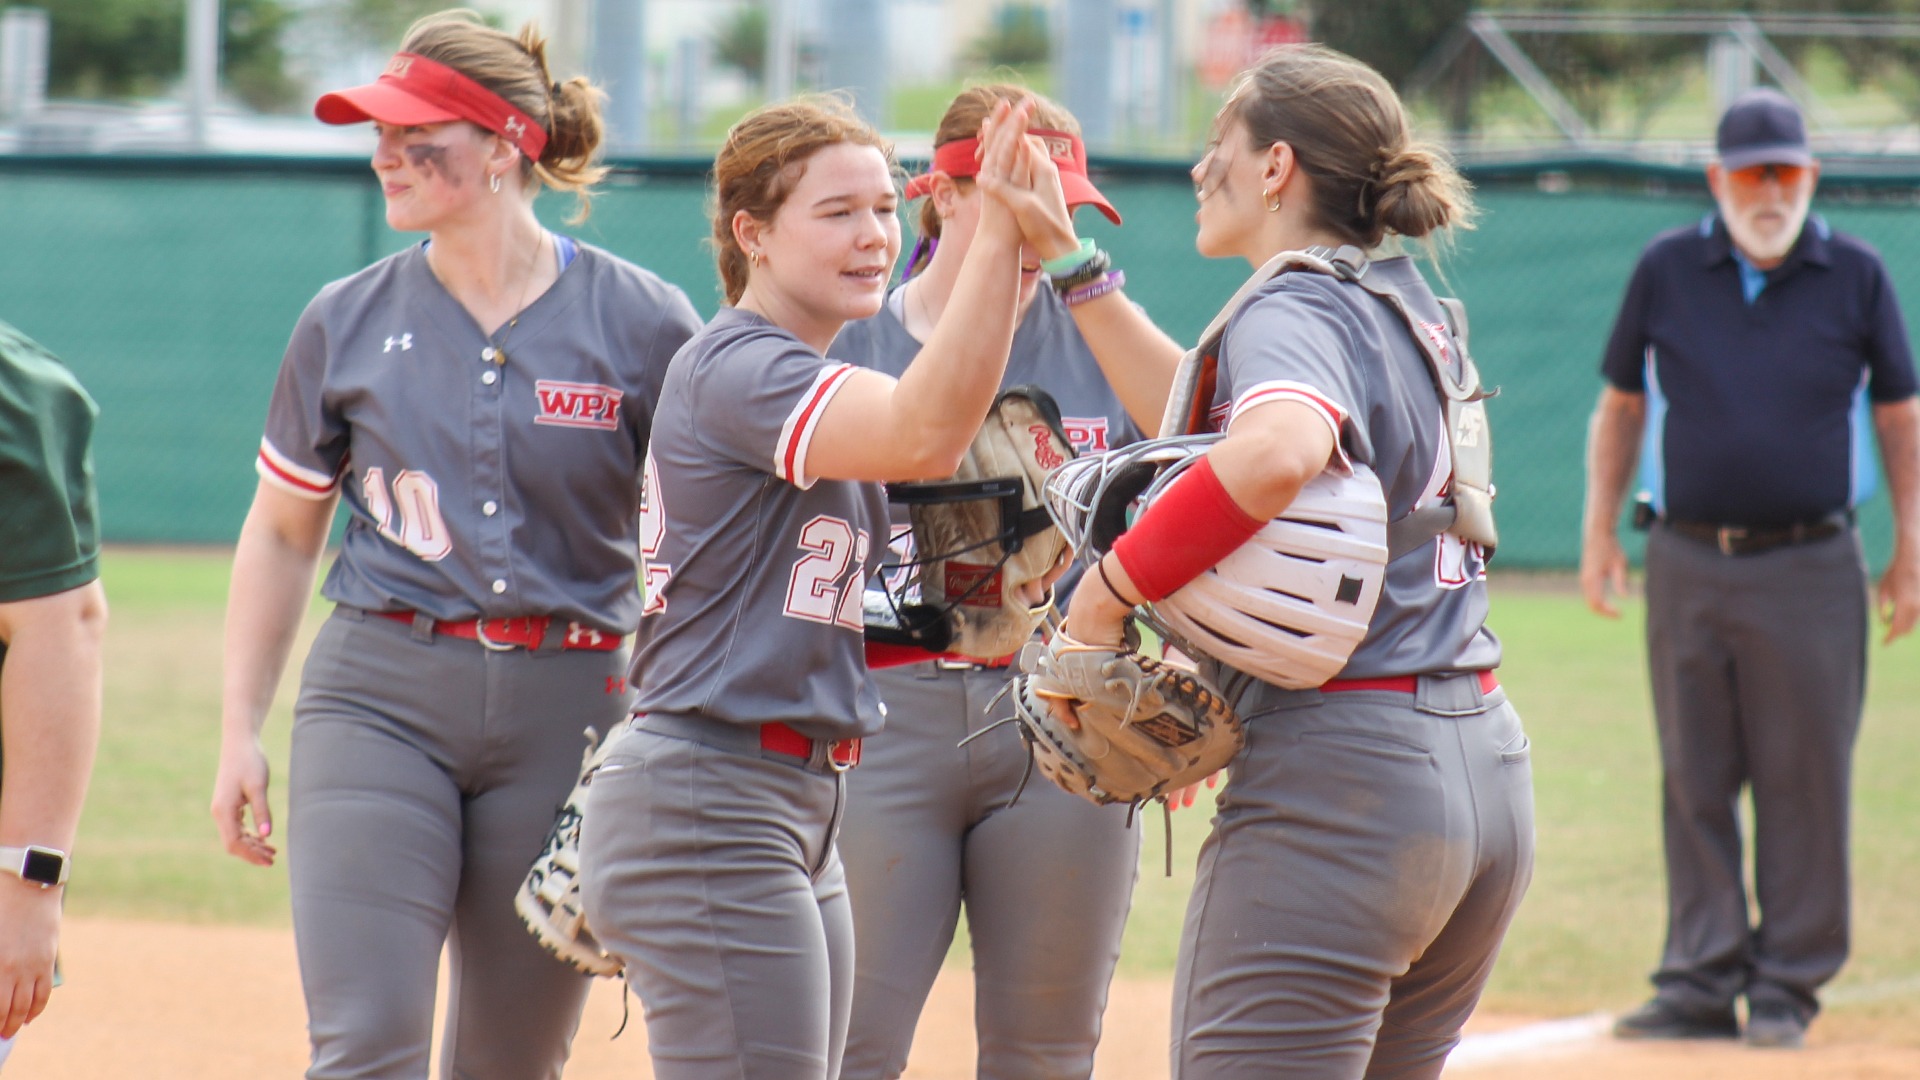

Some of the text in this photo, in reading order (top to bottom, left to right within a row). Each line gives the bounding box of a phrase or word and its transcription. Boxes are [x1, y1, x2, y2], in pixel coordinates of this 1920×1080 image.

[1047, 138, 1074, 160] PI
[536, 388, 621, 421] WPI
[1063, 424, 1108, 454] PI
[363, 467, 452, 561] 10
